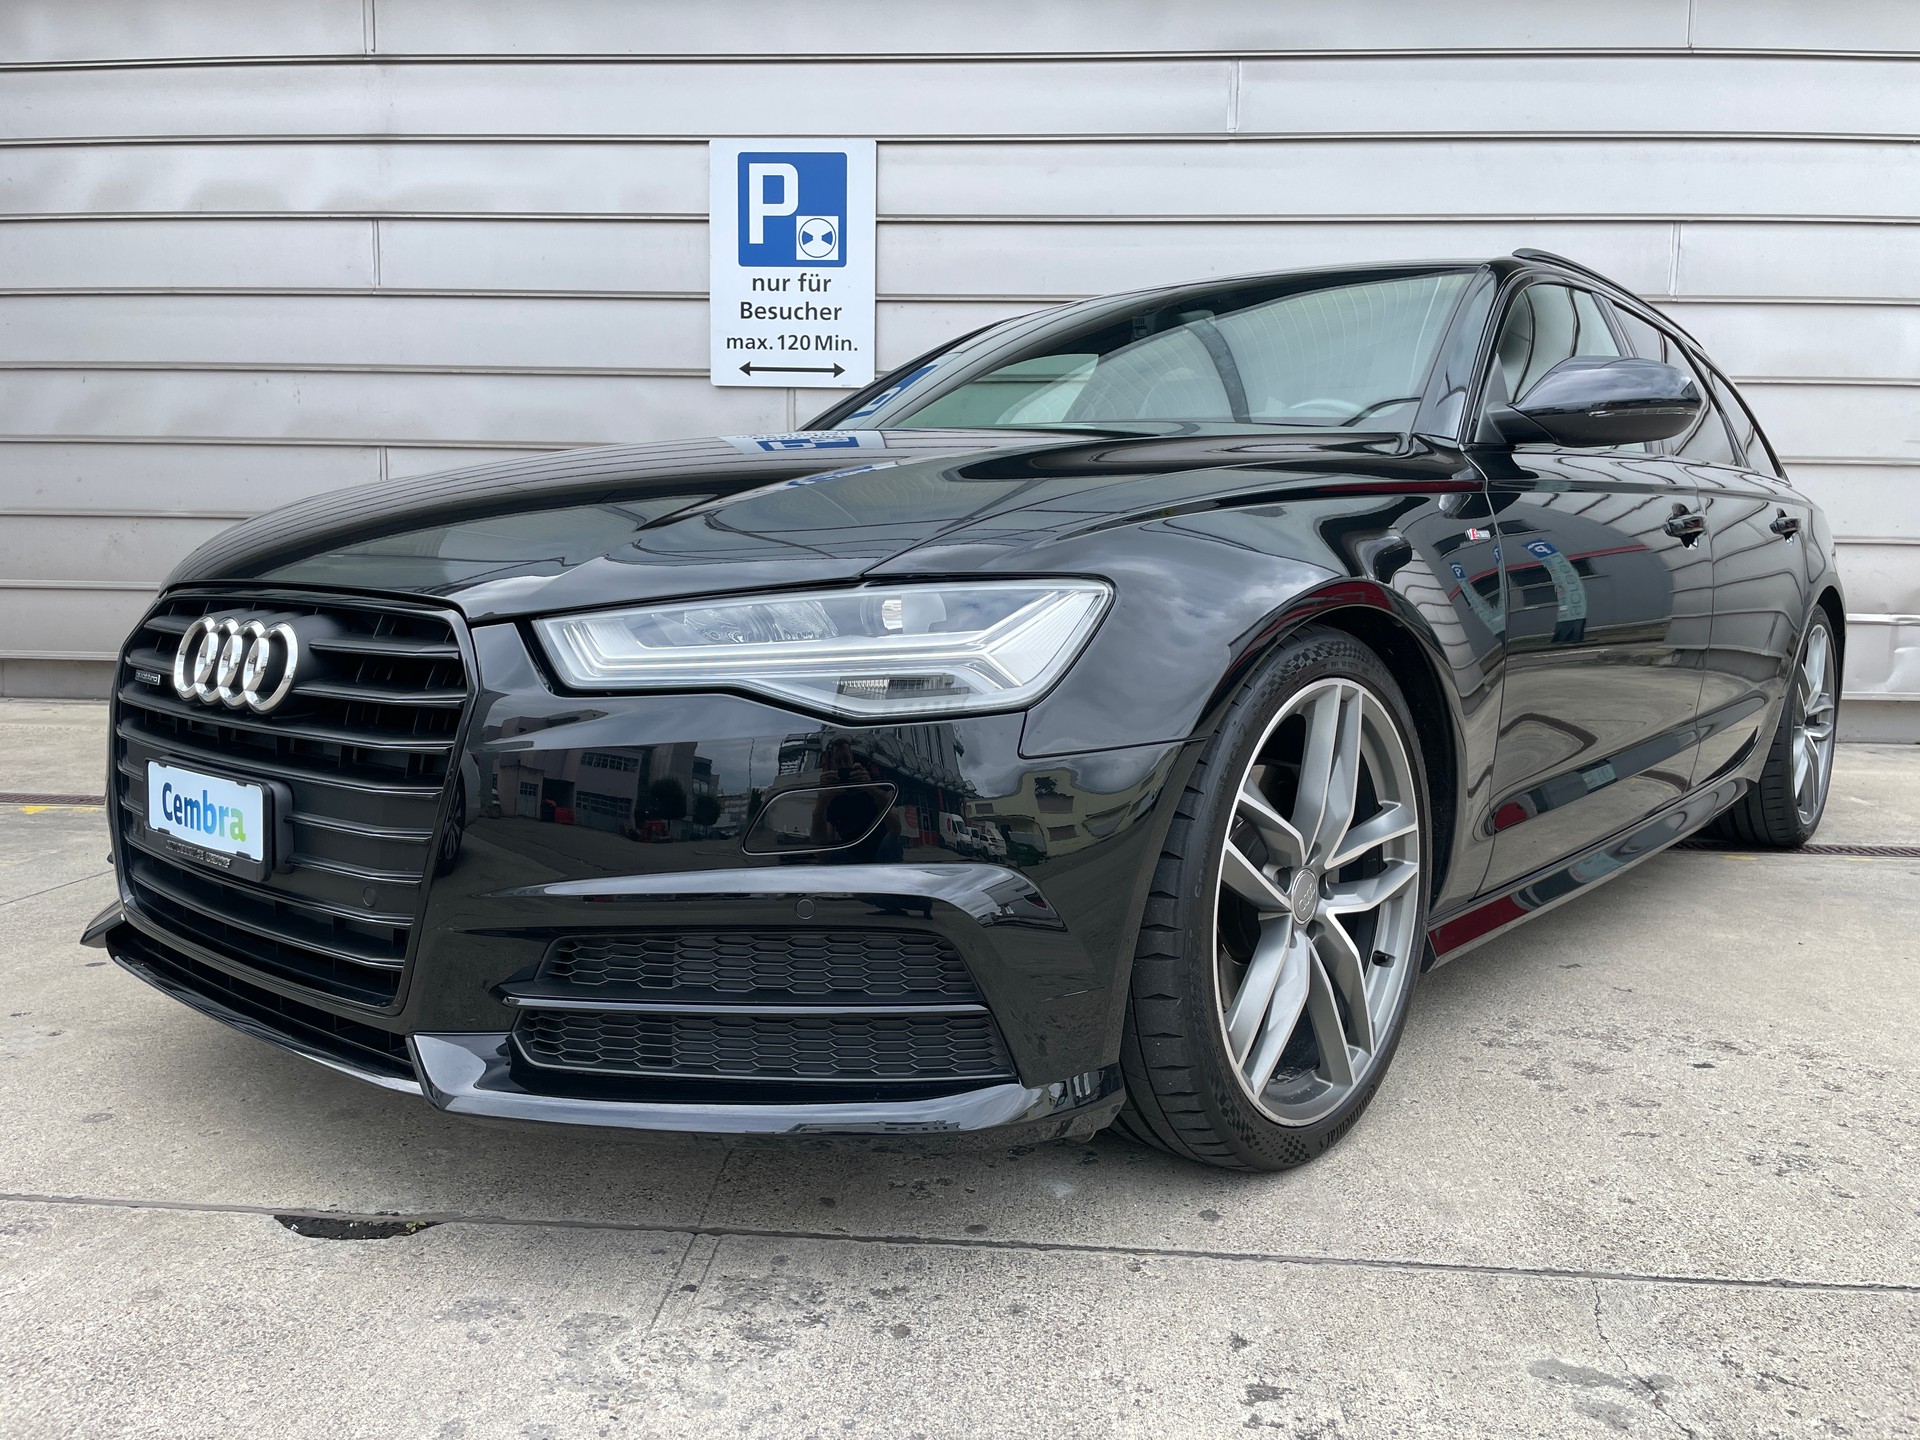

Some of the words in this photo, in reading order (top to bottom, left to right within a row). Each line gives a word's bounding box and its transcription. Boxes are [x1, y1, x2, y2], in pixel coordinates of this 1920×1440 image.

[749, 163, 799, 244] P
[752, 277, 791, 292] nur
[797, 272, 832, 292] für
[740, 301, 842, 321] Besucher
[726, 336, 774, 350] max.
[777, 334, 811, 351] 120
[815, 334, 858, 352] Min.
[162, 782, 247, 842] Cembra
